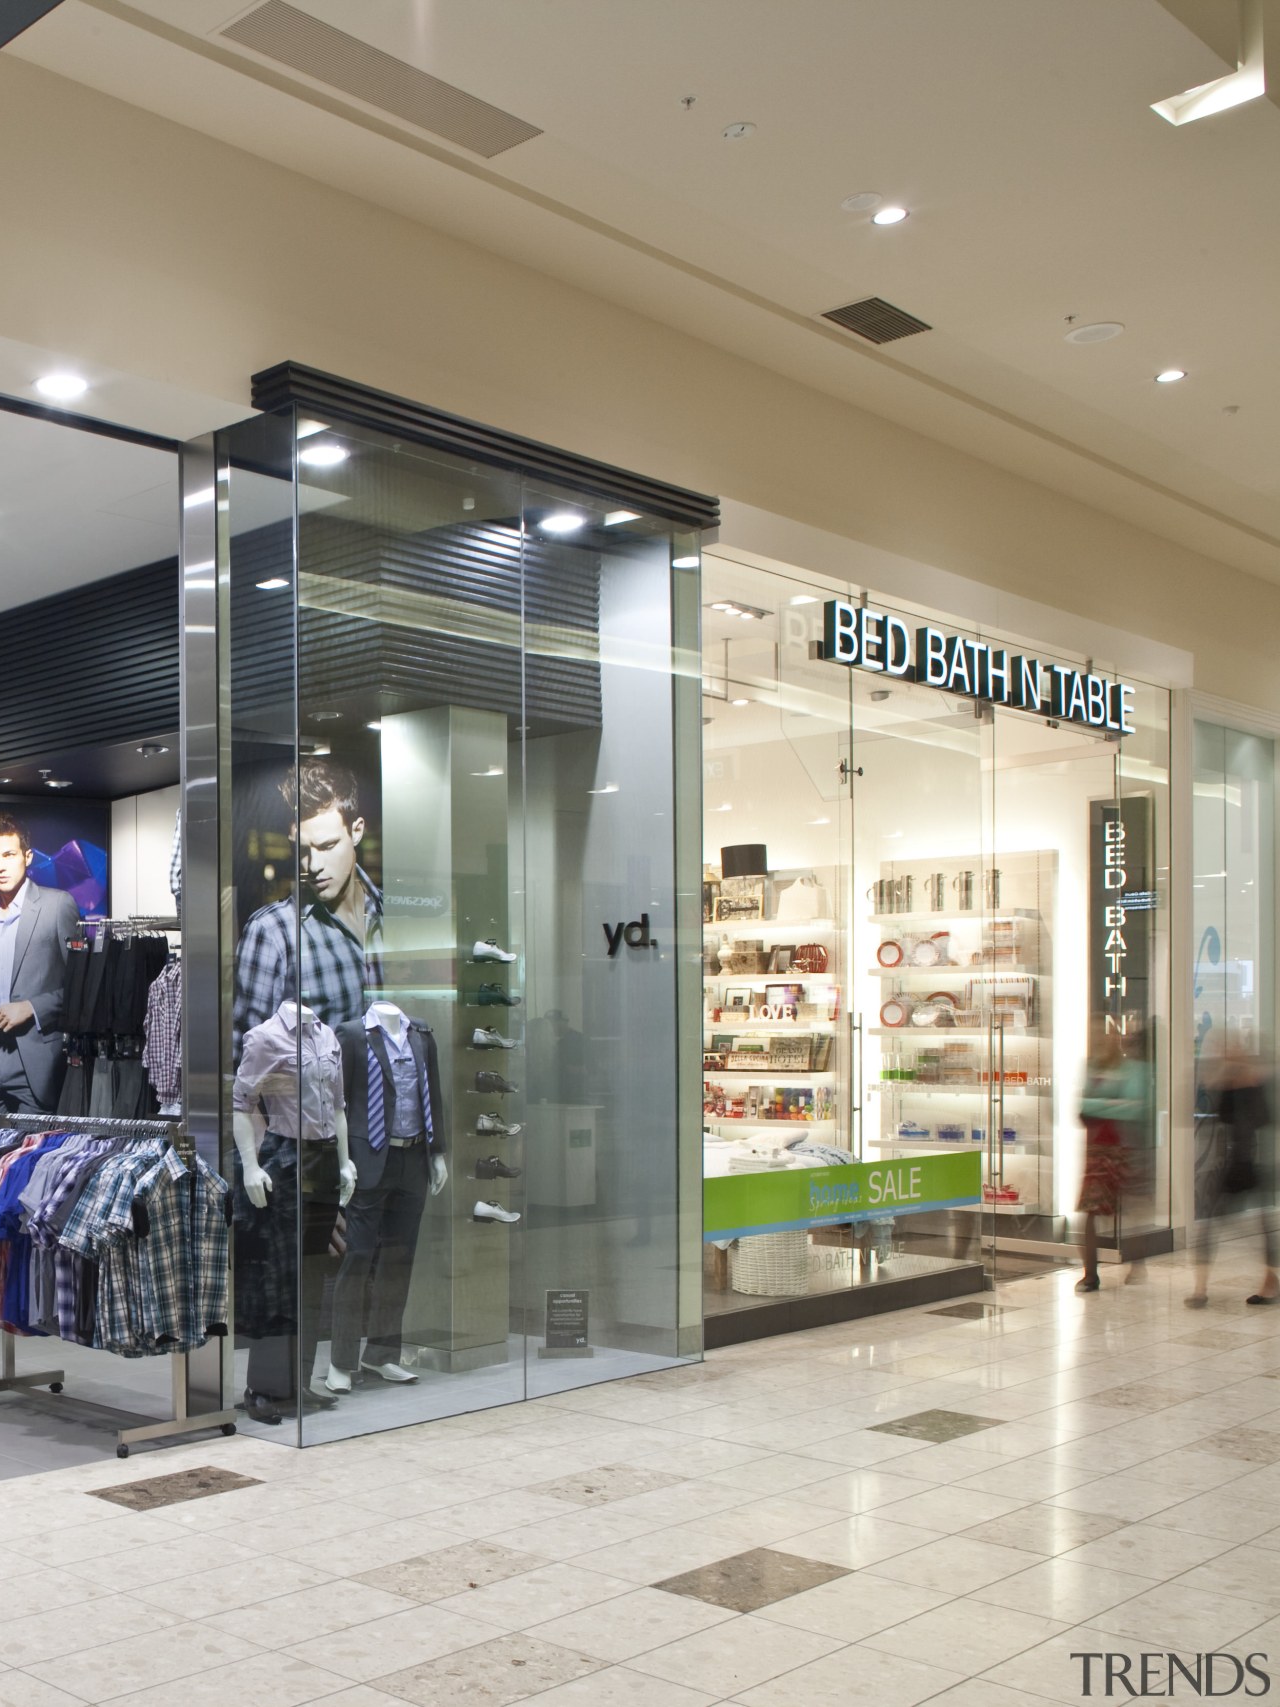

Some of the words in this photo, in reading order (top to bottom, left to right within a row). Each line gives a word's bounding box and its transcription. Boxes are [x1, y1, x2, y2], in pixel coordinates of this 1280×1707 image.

[832, 600, 911, 676] BED
[924, 627, 1008, 703] BATH
[1019, 655, 1041, 711] N
[1051, 664, 1136, 734] TABLE
[1104, 821, 1127, 890] BED
[602, 913, 658, 957] yd.
[1104, 906, 1128, 997] BATH
[748, 1004, 794, 1021] LOVE
[769, 1055, 808, 1064] HOTEL
[868, 1166, 922, 1204] SALE
